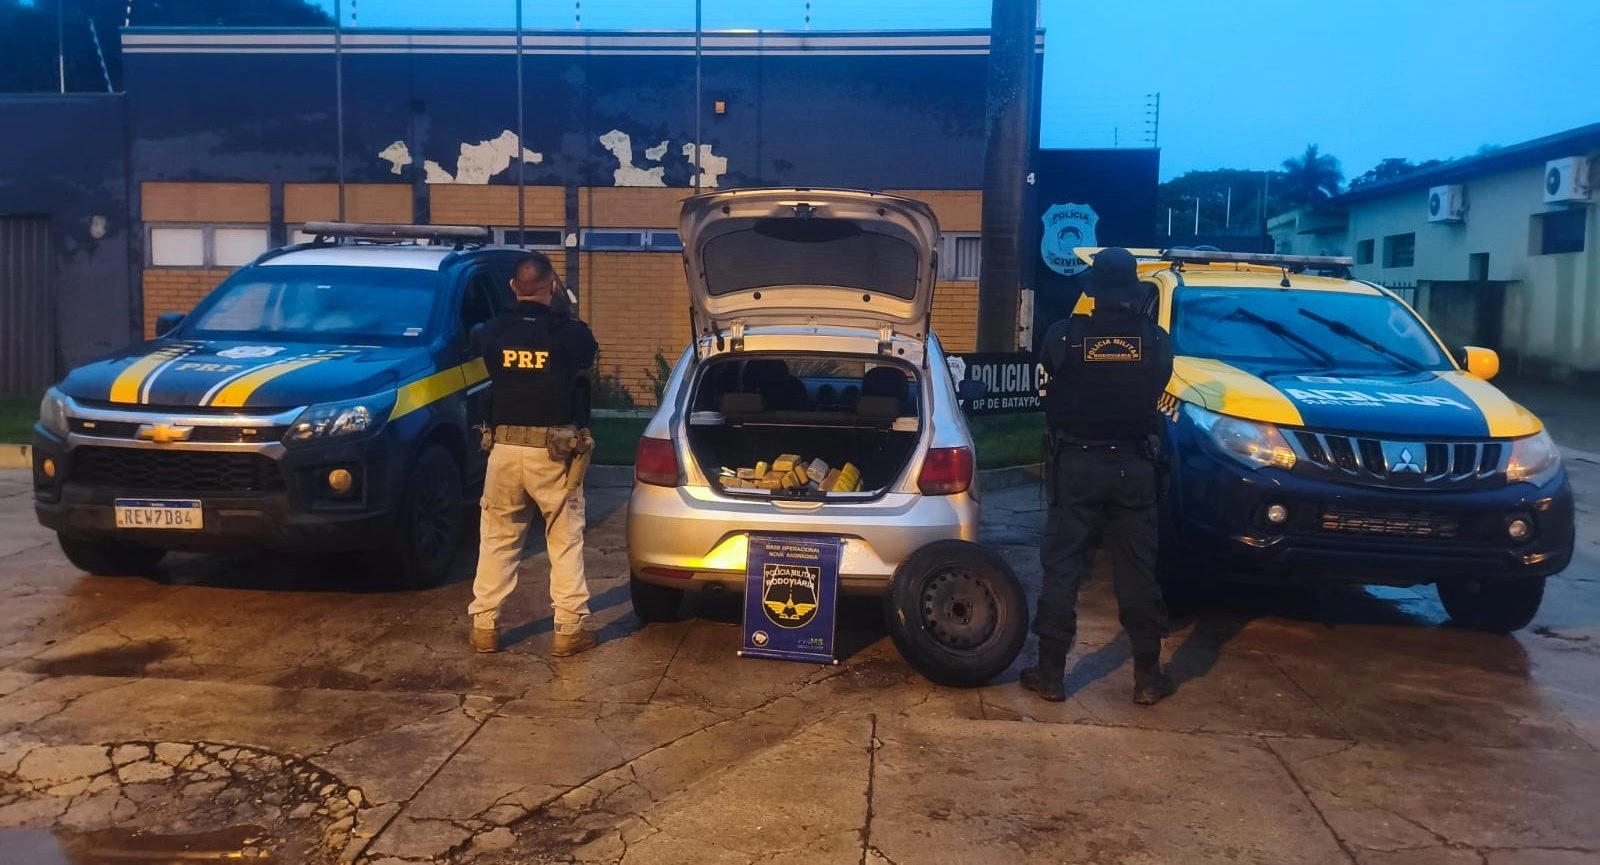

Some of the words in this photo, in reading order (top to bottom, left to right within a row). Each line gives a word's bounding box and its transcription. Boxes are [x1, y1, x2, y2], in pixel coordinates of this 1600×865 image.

[1026, 172, 1036, 185] 4
[502, 349, 549, 369] PRF
[174, 363, 243, 373] PRF
[971, 363, 1031, 393] POLICIA
[972, 399, 985, 410] DP
[987, 398, 1000, 409] DE
[124, 508, 193, 526] REW7D84
